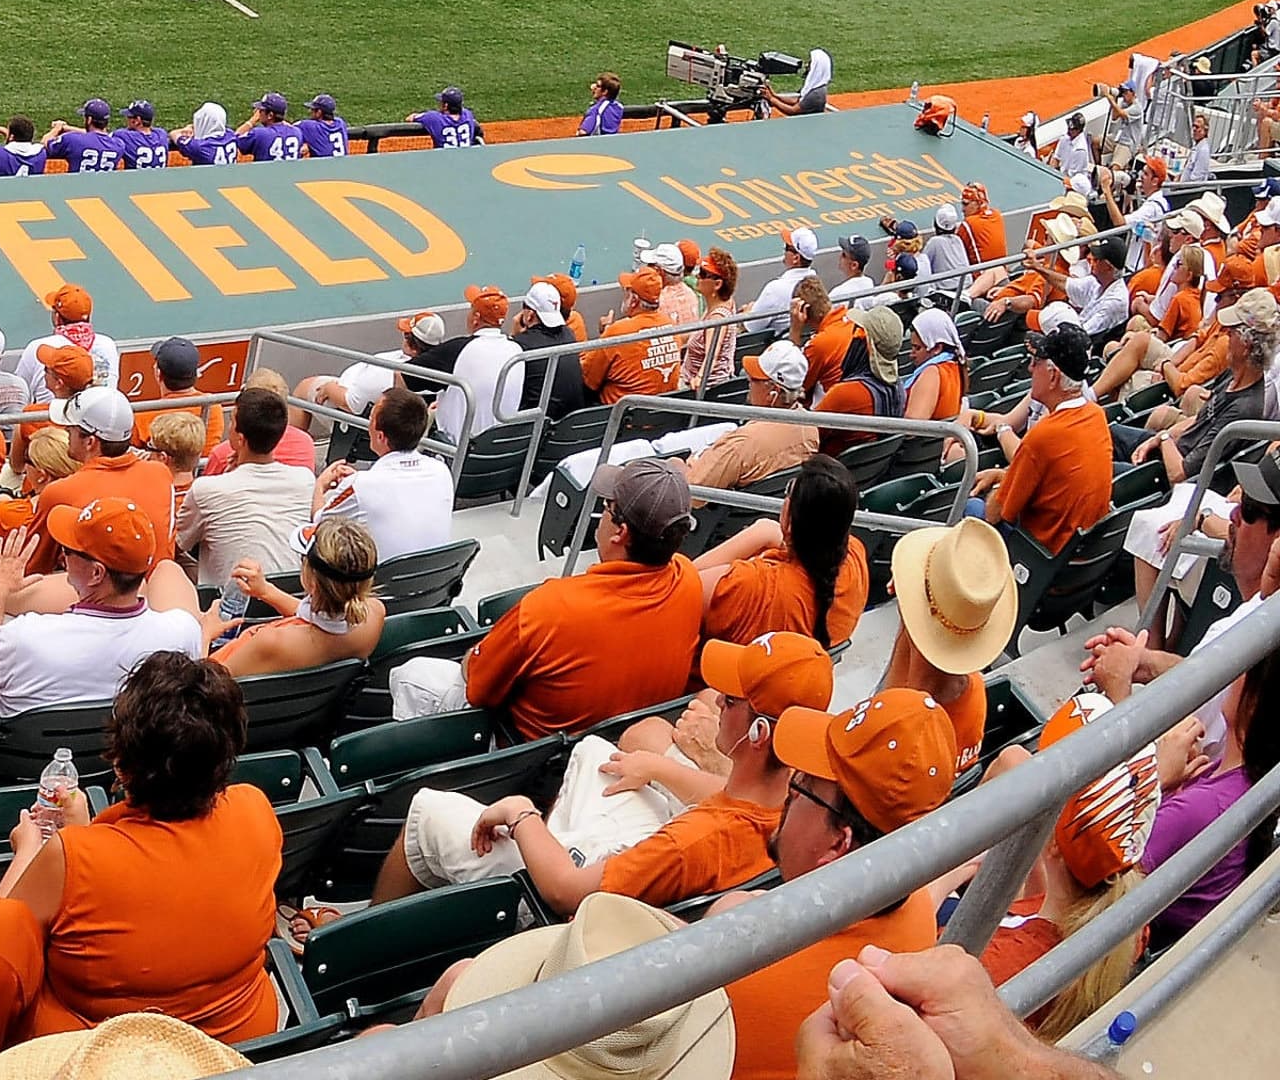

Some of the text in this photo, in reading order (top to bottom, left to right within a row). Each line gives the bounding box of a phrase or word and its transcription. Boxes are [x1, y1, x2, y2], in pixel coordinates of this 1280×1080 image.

[269, 136, 300, 161] 43
[329, 132, 346, 157] 3
[442, 125, 471, 148] 33
[80, 149, 113, 173] 25
[136, 147, 167, 169] 23
[618, 150, 965, 227] University
[714, 191, 960, 243] FEDERAL CREDIT UNION
[127, 372, 144, 397] 2
[227, 363, 238, 386] 1
